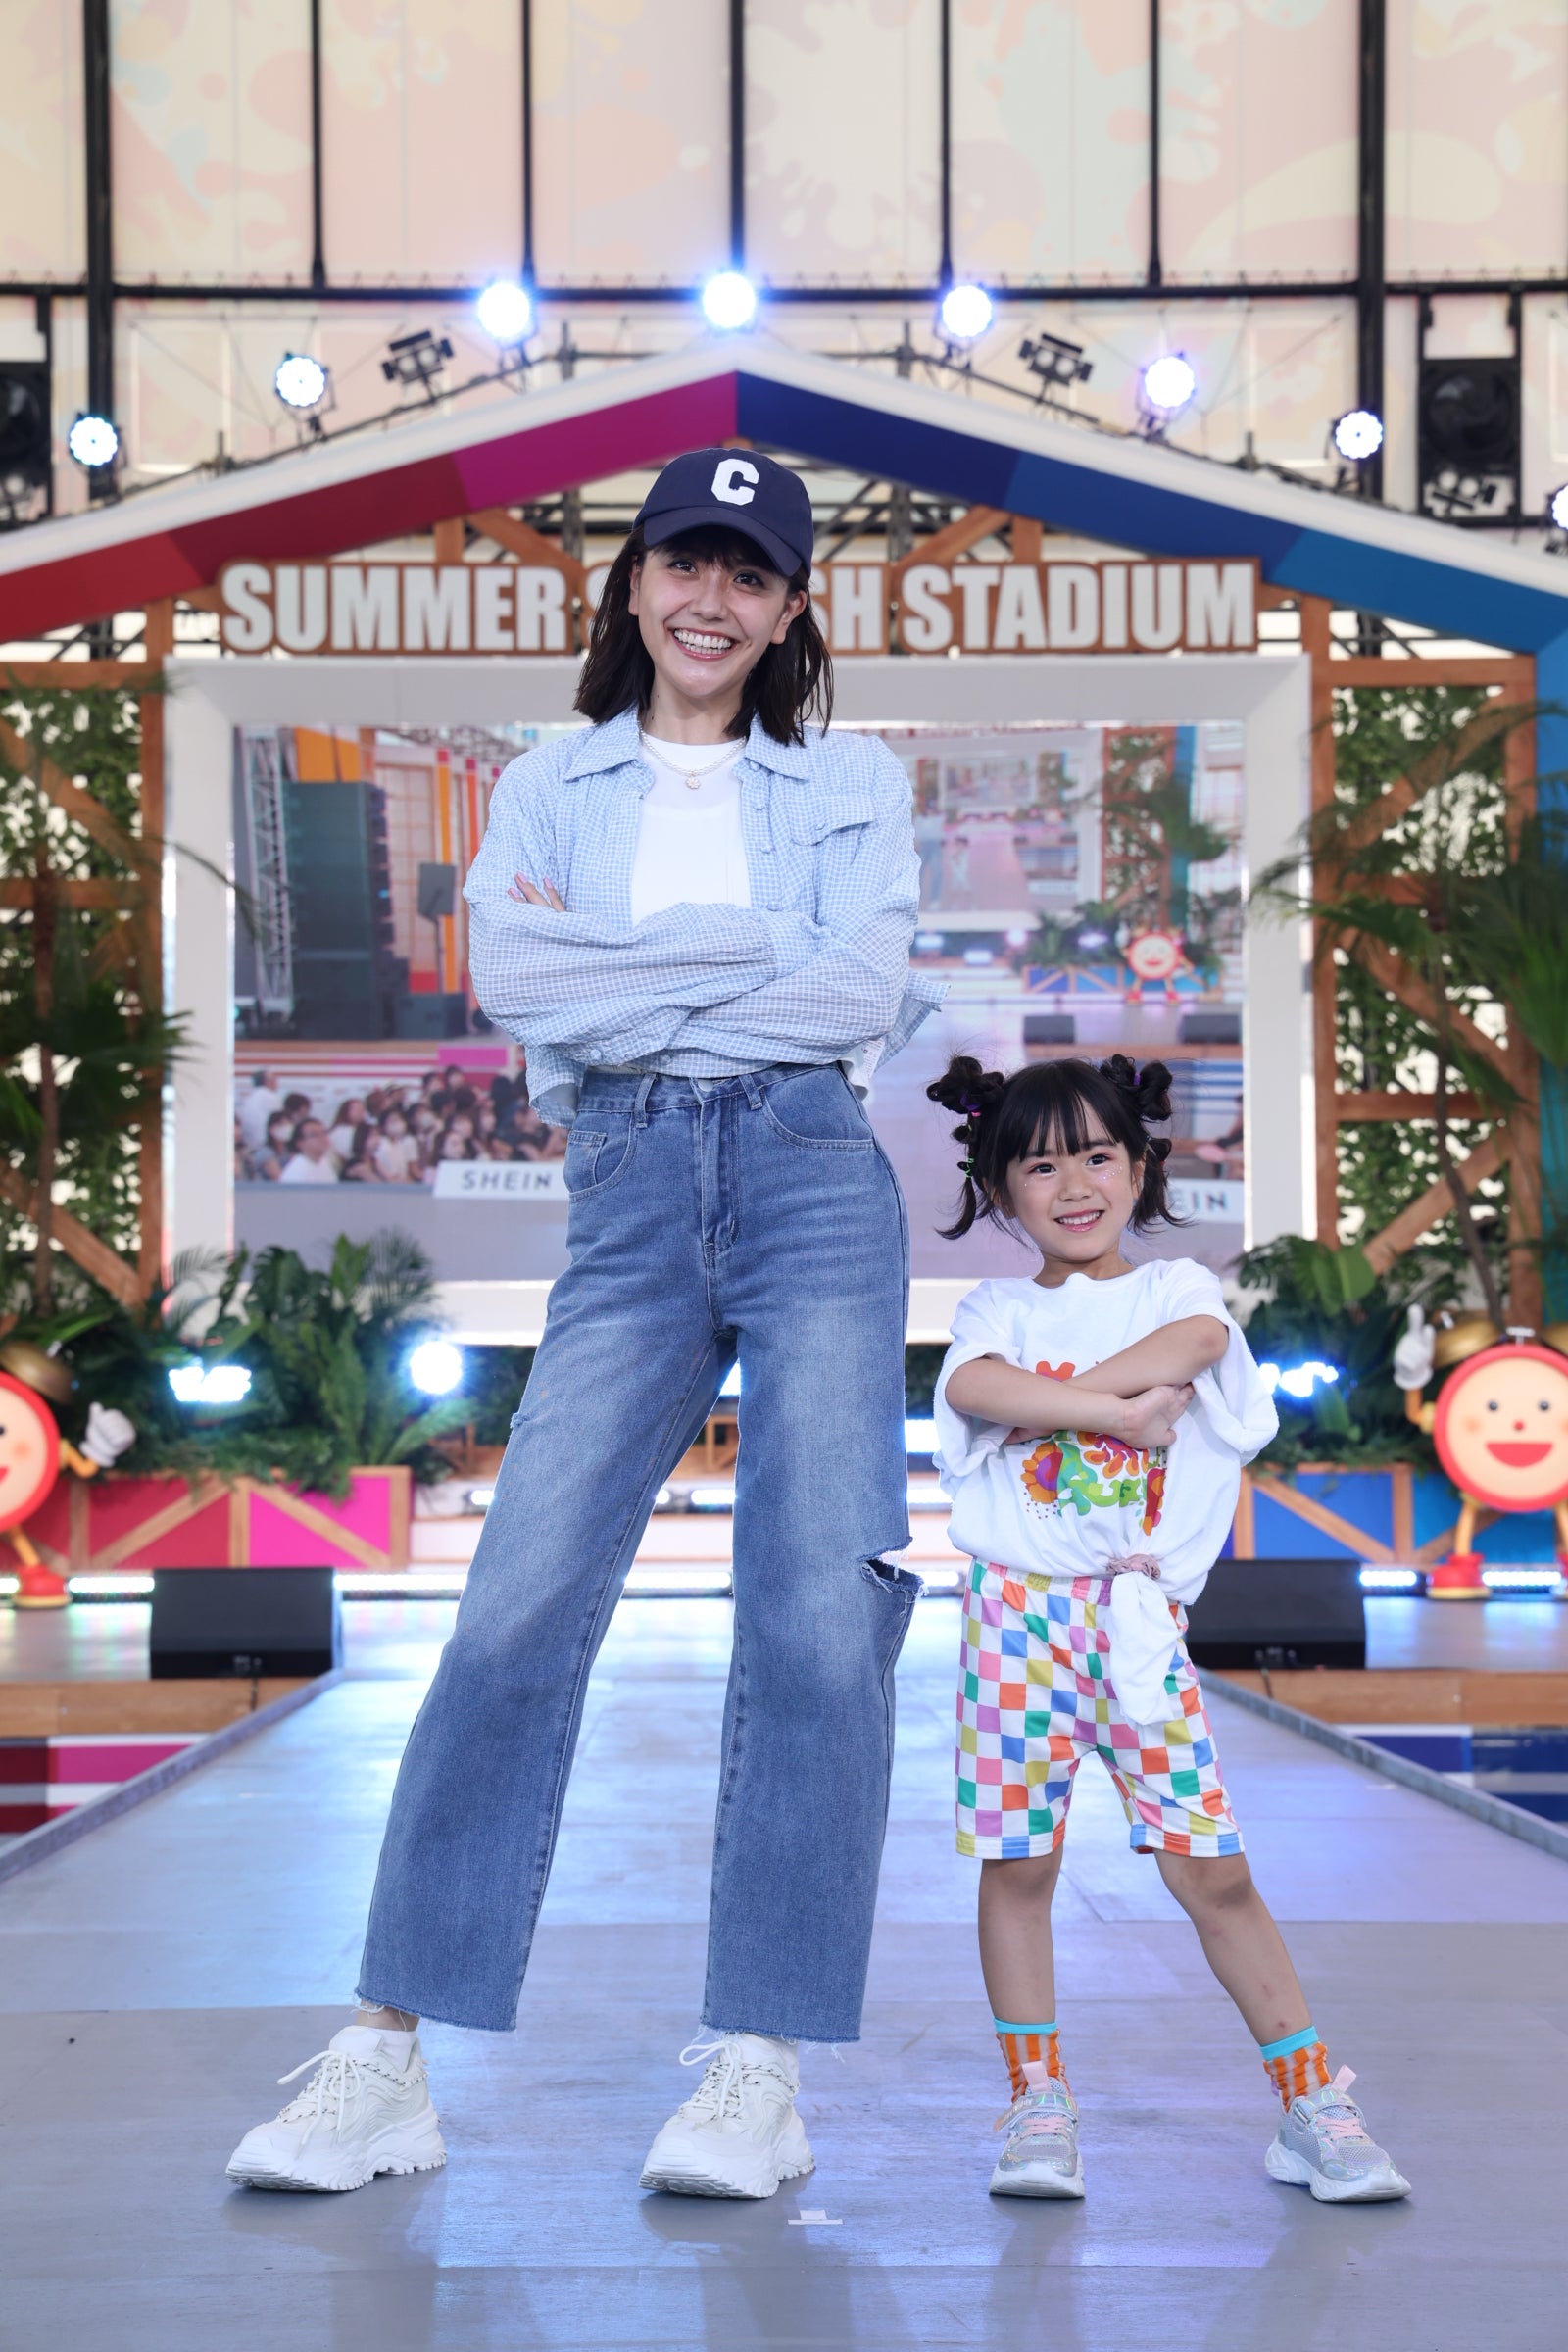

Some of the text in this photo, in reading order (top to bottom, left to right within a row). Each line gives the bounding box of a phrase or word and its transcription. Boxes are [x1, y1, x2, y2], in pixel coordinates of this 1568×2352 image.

[711, 458, 760, 506] C
[221, 564, 566, 652] SUMMER
[902, 564, 1253, 652] STADIUM
[462, 1169, 551, 1191] SHEIN
[1169, 1189, 1227, 1211] EIN
